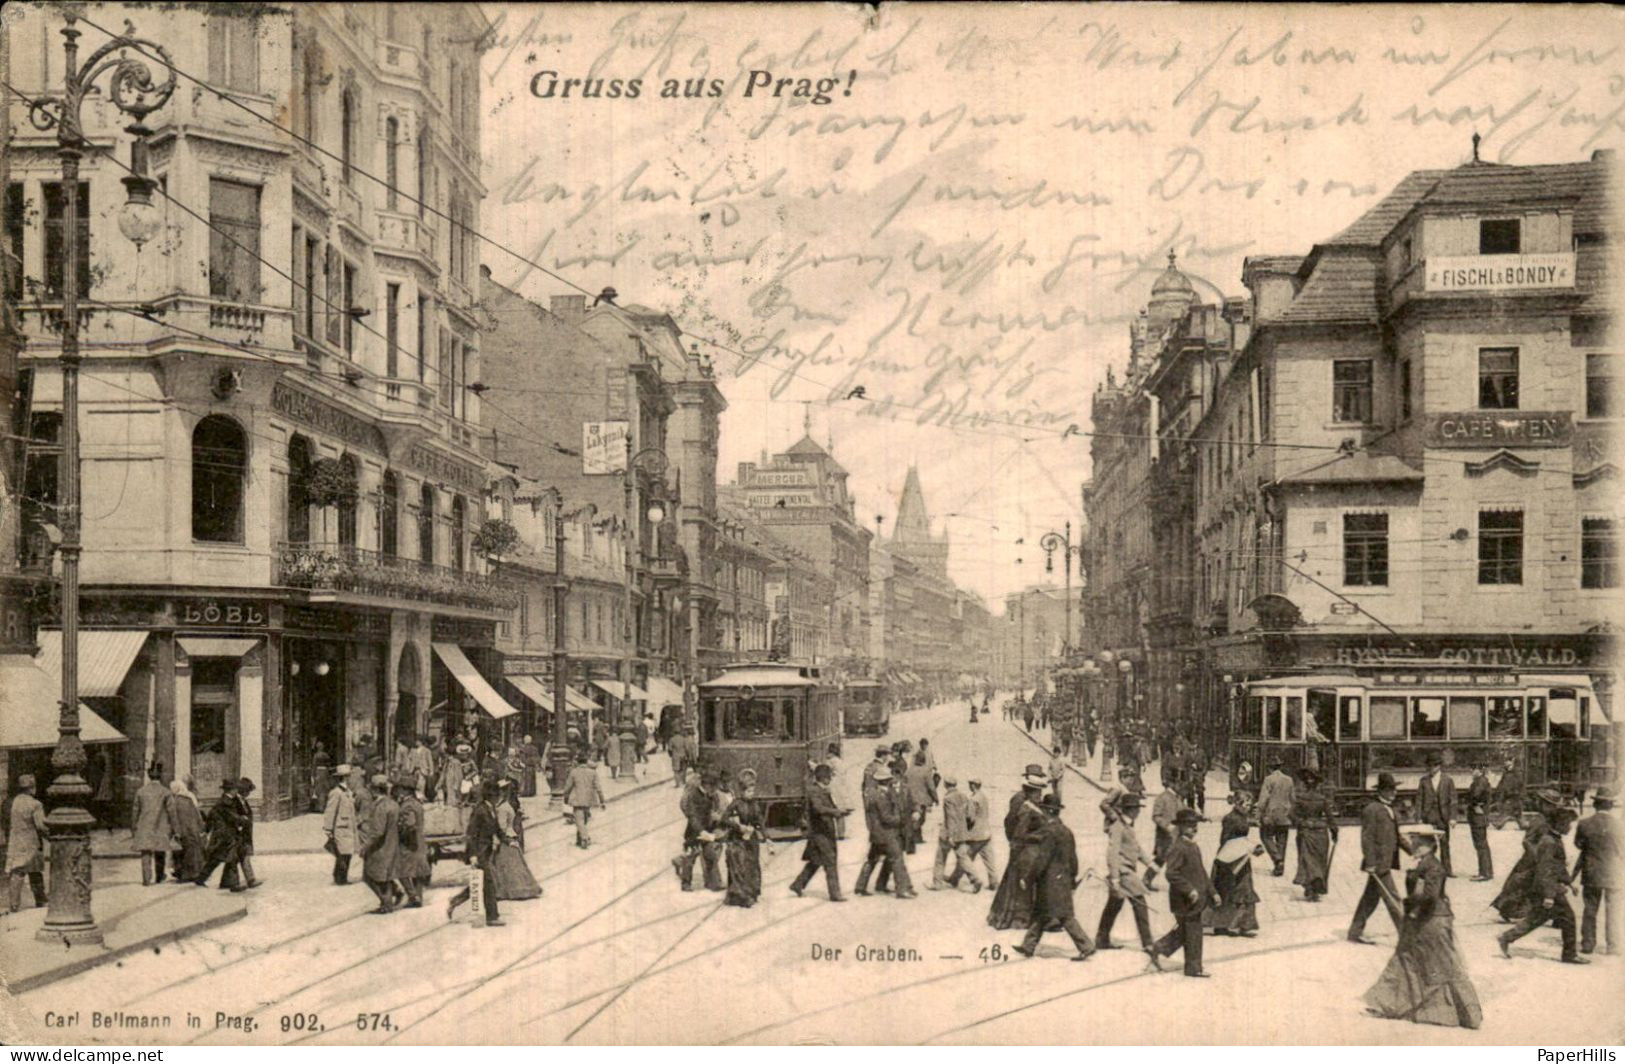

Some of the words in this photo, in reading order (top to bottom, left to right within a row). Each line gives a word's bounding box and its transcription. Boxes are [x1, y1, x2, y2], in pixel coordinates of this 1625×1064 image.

[529, 69, 644, 99] Gruss
[660, 77, 725, 98] aus
[743, 69, 857, 105] Prag!
[1441, 417, 1493, 438] CAFÉ
[184, 602, 263, 624] LÖBL
[811, 943, 843, 962] Der
[855, 944, 922, 962] Graben.
[45, 1011, 80, 1028] Carl
[187, 1012, 201, 1028] in
[215, 1012, 260, 1033] Prag.
